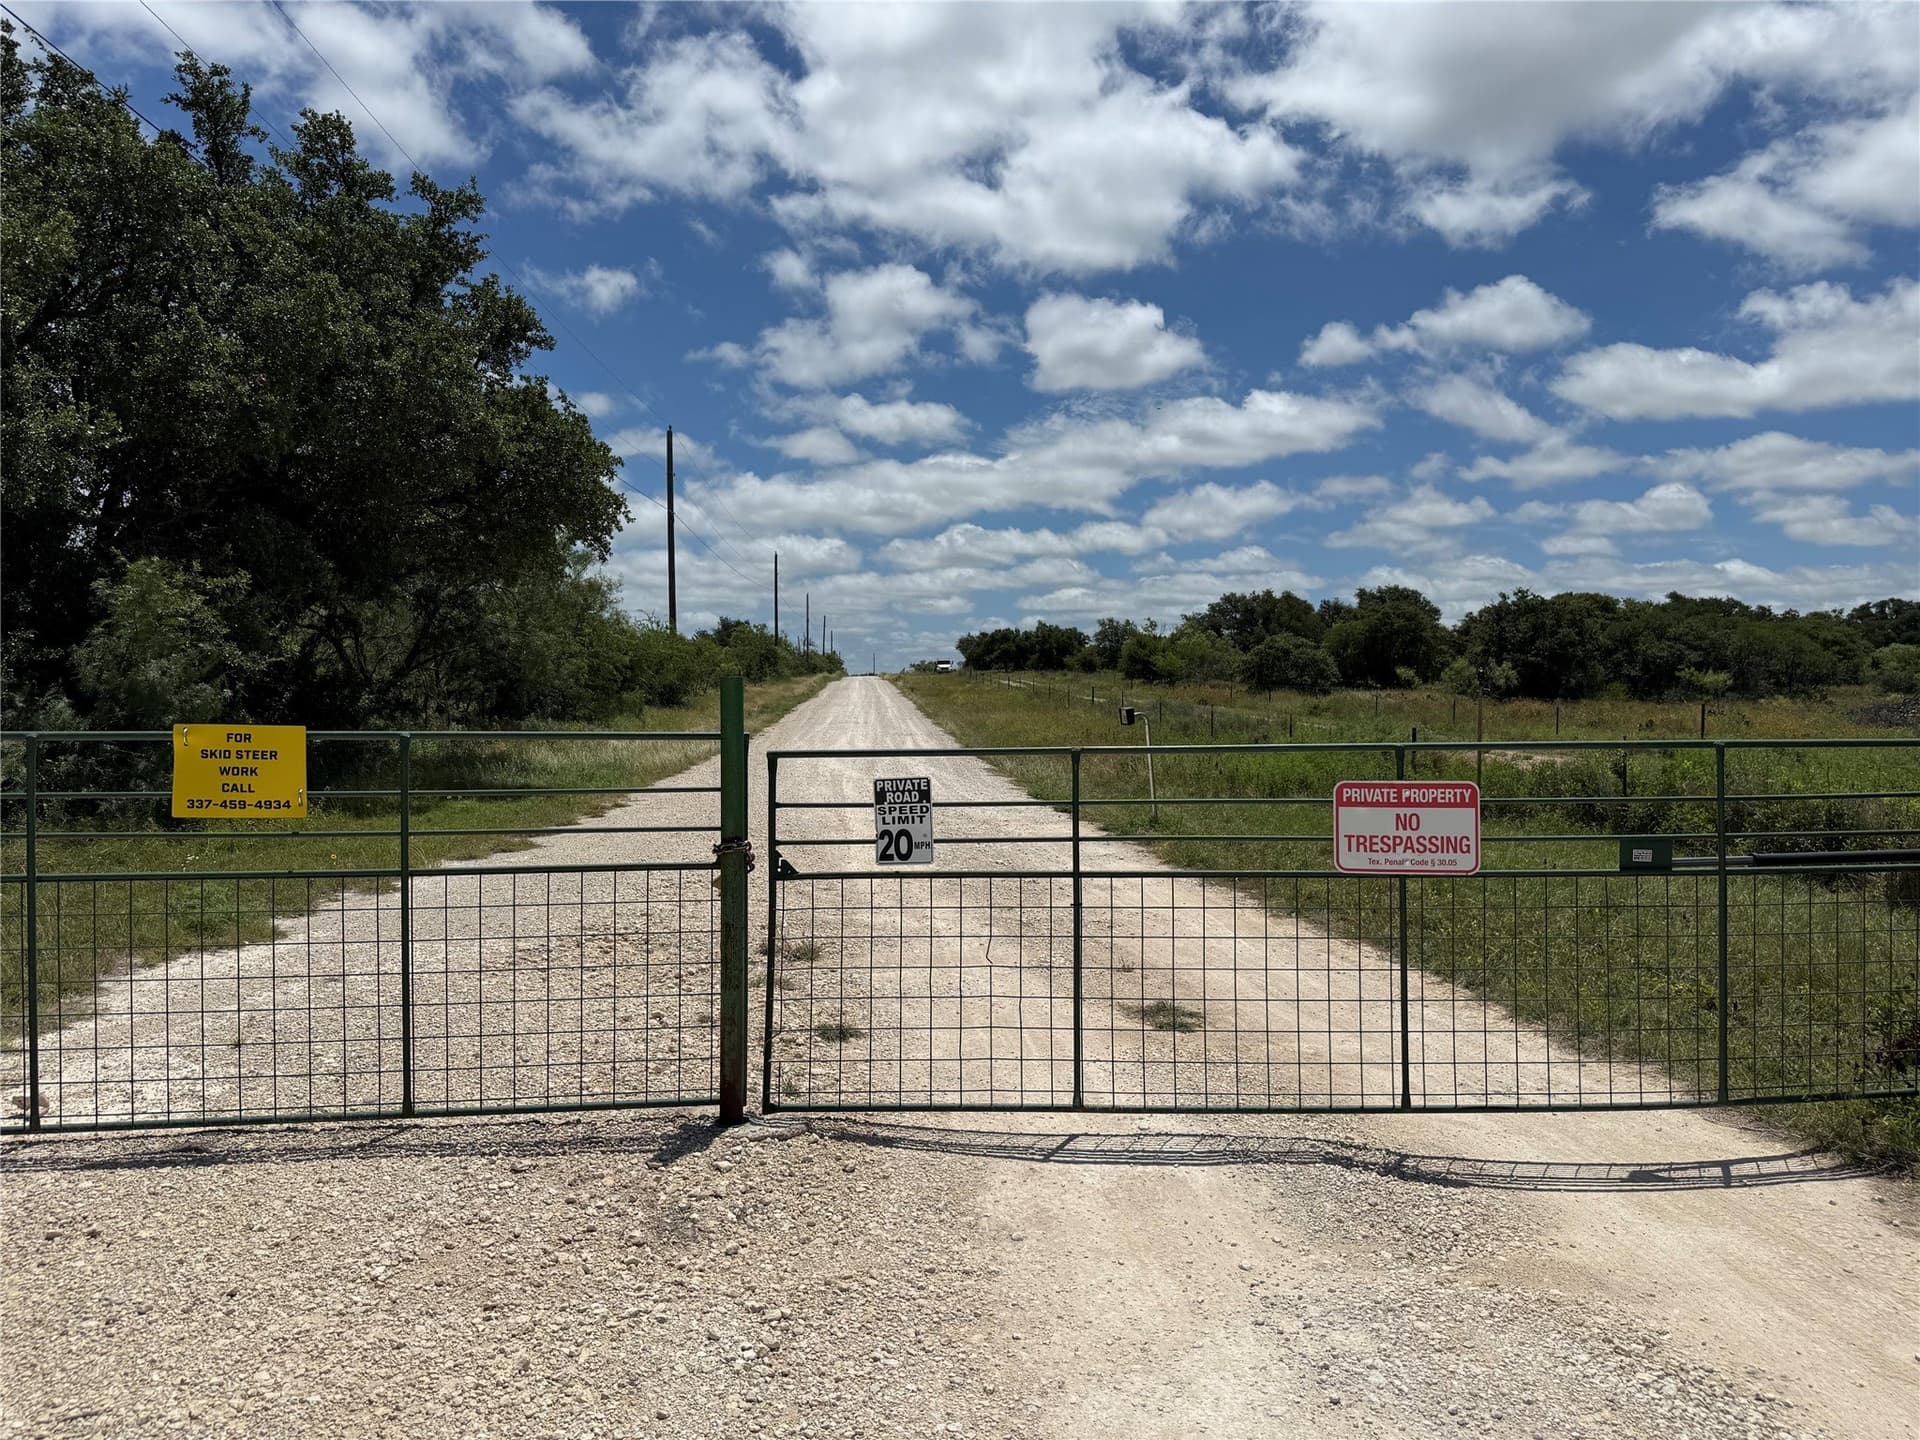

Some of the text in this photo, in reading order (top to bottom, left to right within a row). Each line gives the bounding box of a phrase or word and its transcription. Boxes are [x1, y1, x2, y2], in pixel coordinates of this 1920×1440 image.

[226, 733, 252, 743] FOR
[200, 749, 278, 760] SKID STEER
[219, 766, 258, 776] WORK
[221, 783, 255, 793] CALL
[876, 779, 928, 791] PRIVATE
[886, 791, 919, 803] ROAD
[1343, 788, 1471, 803] PRIVATE PROPERTY
[187, 799, 291, 810] 337-459-4934
[878, 805, 929, 815] SPEED
[882, 815, 926, 825] LIMIT
[1395, 813, 1420, 831] NO
[879, 829, 930, 861] 20 MPH
[1344, 835, 1471, 854] TRESPASSING
[1384, 858, 1404, 866] Penal
[1410, 858, 1428, 866] Code
[1430, 858, 1435, 867] §
